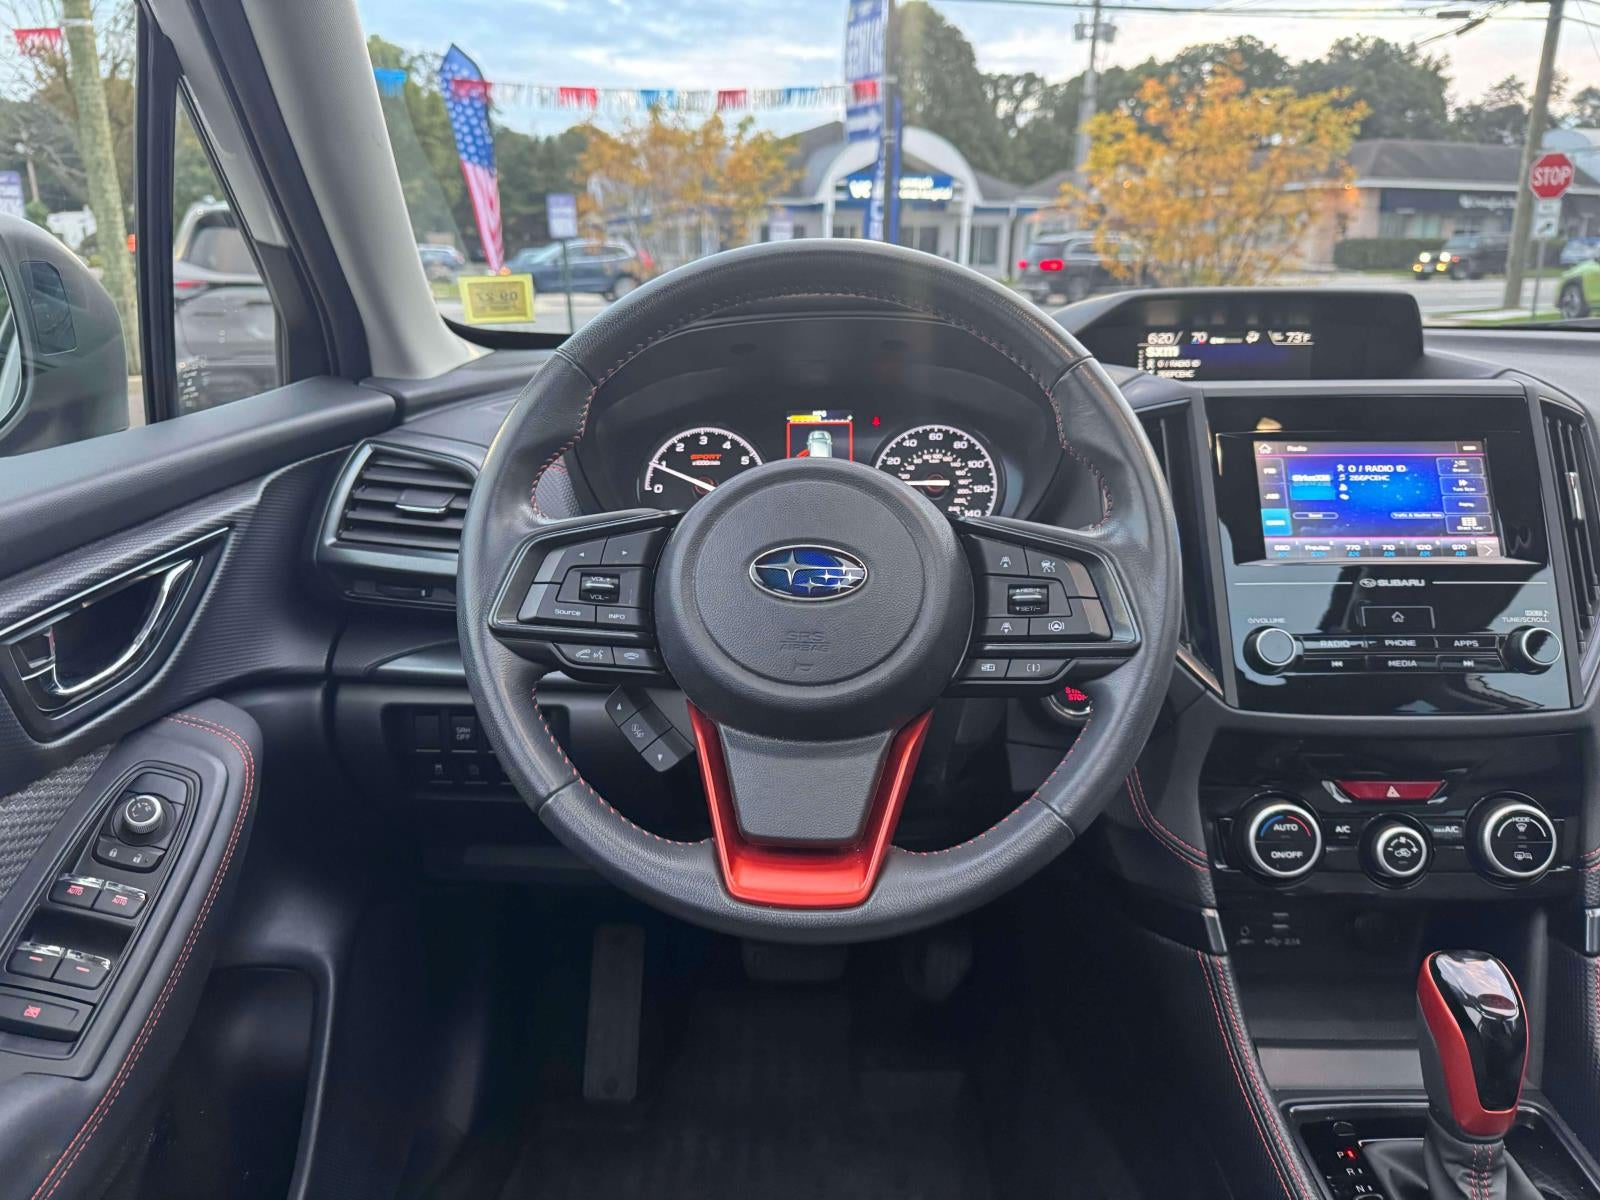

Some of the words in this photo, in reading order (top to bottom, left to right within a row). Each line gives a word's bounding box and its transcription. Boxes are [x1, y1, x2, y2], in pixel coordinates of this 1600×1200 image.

[1533, 165, 1572, 187] STOP
[699, 436, 708, 445] 3
[903, 439, 917, 447] 40
[675, 443, 685, 452] 2
[722, 441, 732, 450] 4
[953, 441, 968, 449] 80
[740, 456, 750, 465] 5
[887, 457, 901, 465] 20
[967, 460, 985, 468] 100
[1365, 464, 1394, 473] RADIO
[1396, 464, 1407, 473] ID
[653, 484, 663, 493] 0
[974, 485, 991, 493] 120
[964, 509, 981, 517] 140
[1377, 578, 1425, 587] SUBARU
[554, 608, 581, 616] Source
[1320, 640, 1350, 648] RADIO
[1335, 825, 1350, 833] A/C
[1271, 851, 1303, 859] ON/OFF
[67, 888, 84, 896] AUTO
[112, 897, 129, 906] AUTO
[1336, 1151, 1344, 1159] P
[1346, 1168, 1356, 1176] R
[1355, 1185, 1366, 1193] N
